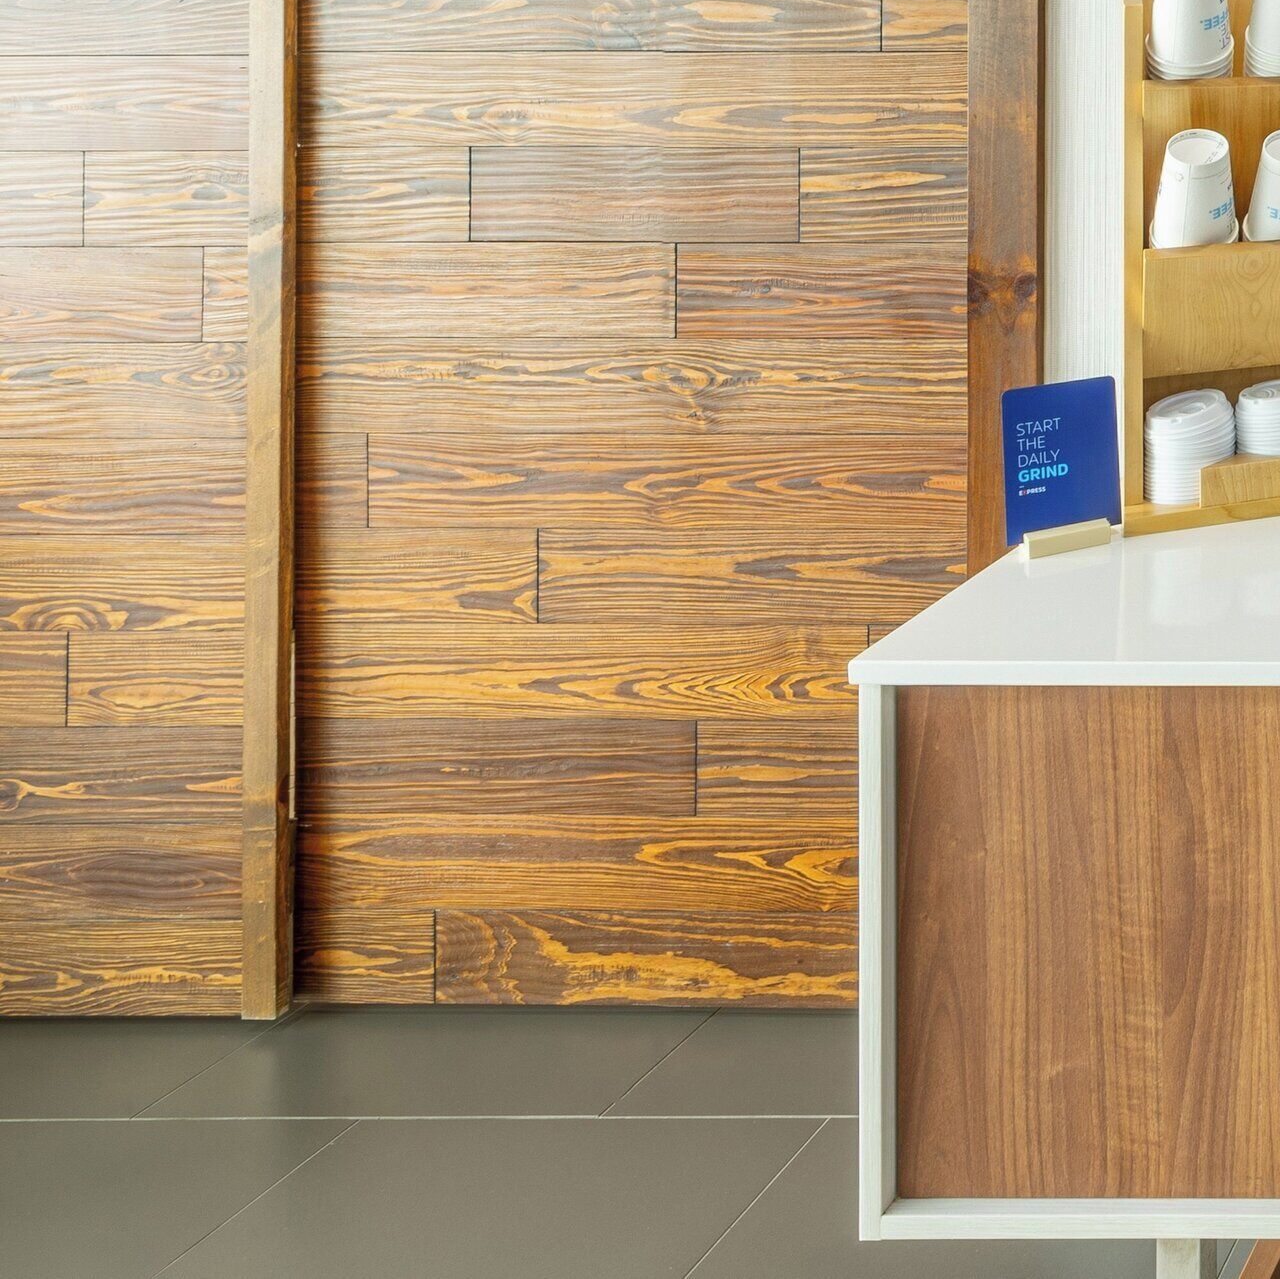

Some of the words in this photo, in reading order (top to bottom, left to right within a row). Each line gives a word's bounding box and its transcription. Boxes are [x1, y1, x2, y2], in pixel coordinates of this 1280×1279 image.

[1016, 417, 1061, 436] START
[1017, 435, 1046, 451] THE
[1018, 448, 1060, 468] DAILY
[1018, 463, 1068, 483] GRIND
[1018, 486, 1046, 496] EXPRESS
